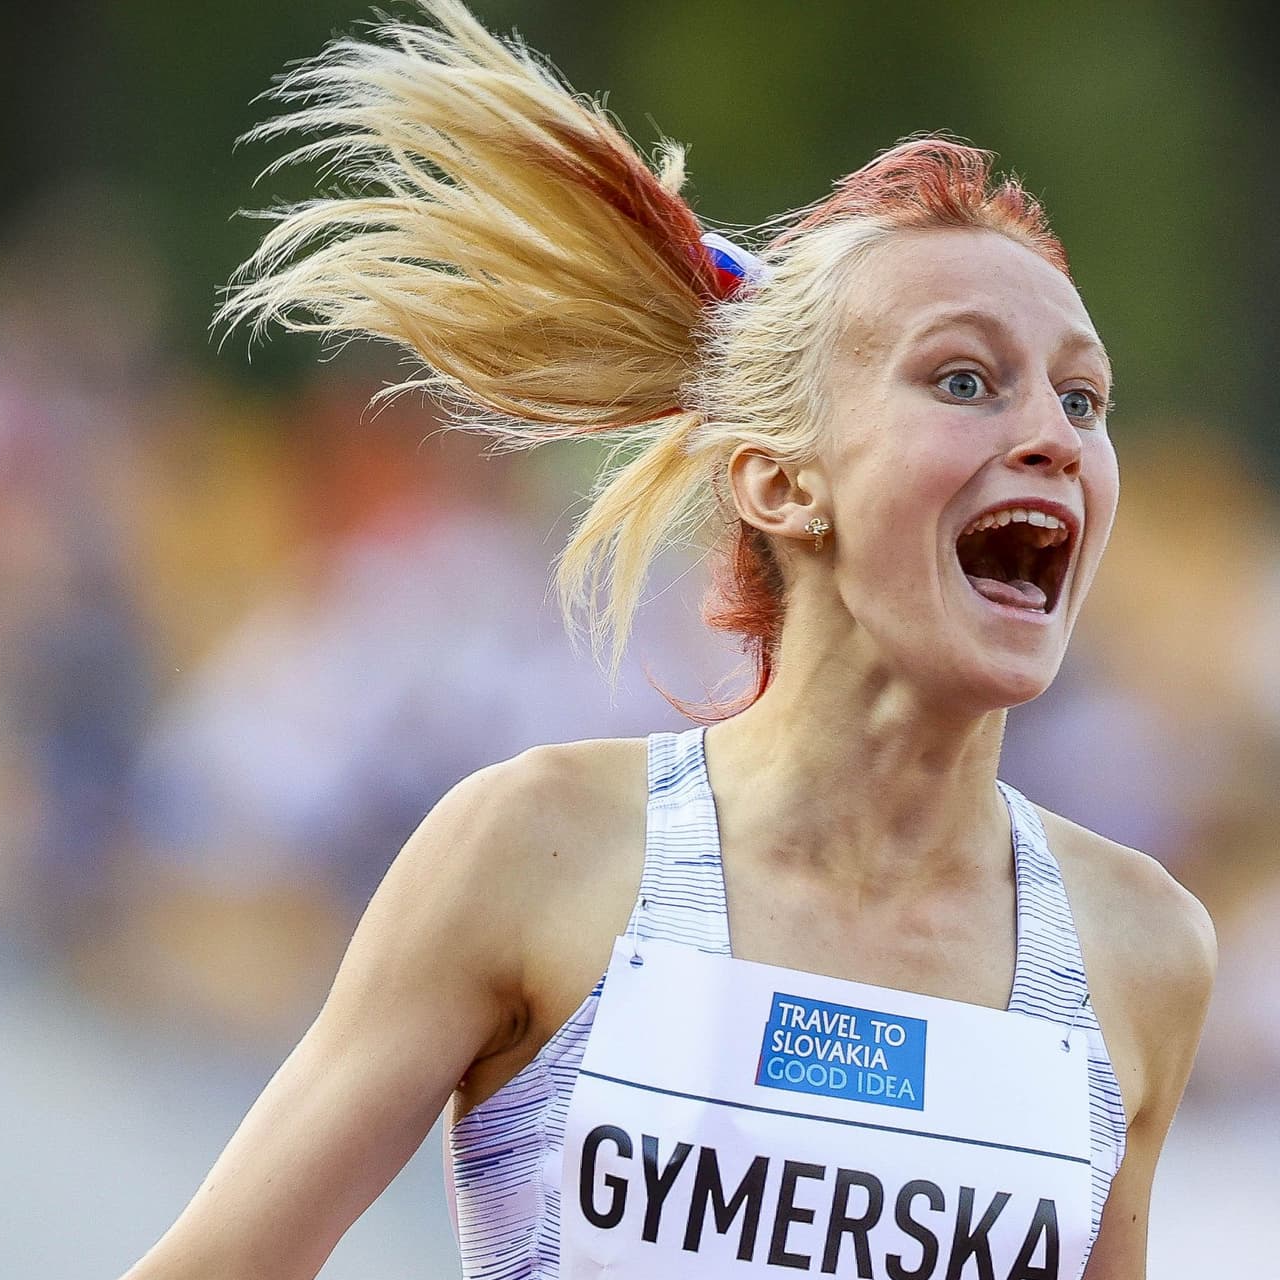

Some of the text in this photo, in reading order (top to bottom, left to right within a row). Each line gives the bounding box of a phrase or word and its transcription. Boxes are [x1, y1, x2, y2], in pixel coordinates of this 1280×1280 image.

[778, 1001, 906, 1047] TRAVEL TO
[771, 1029, 888, 1071] SLOVAKIA
[766, 1056, 916, 1101] GOOD IDEA
